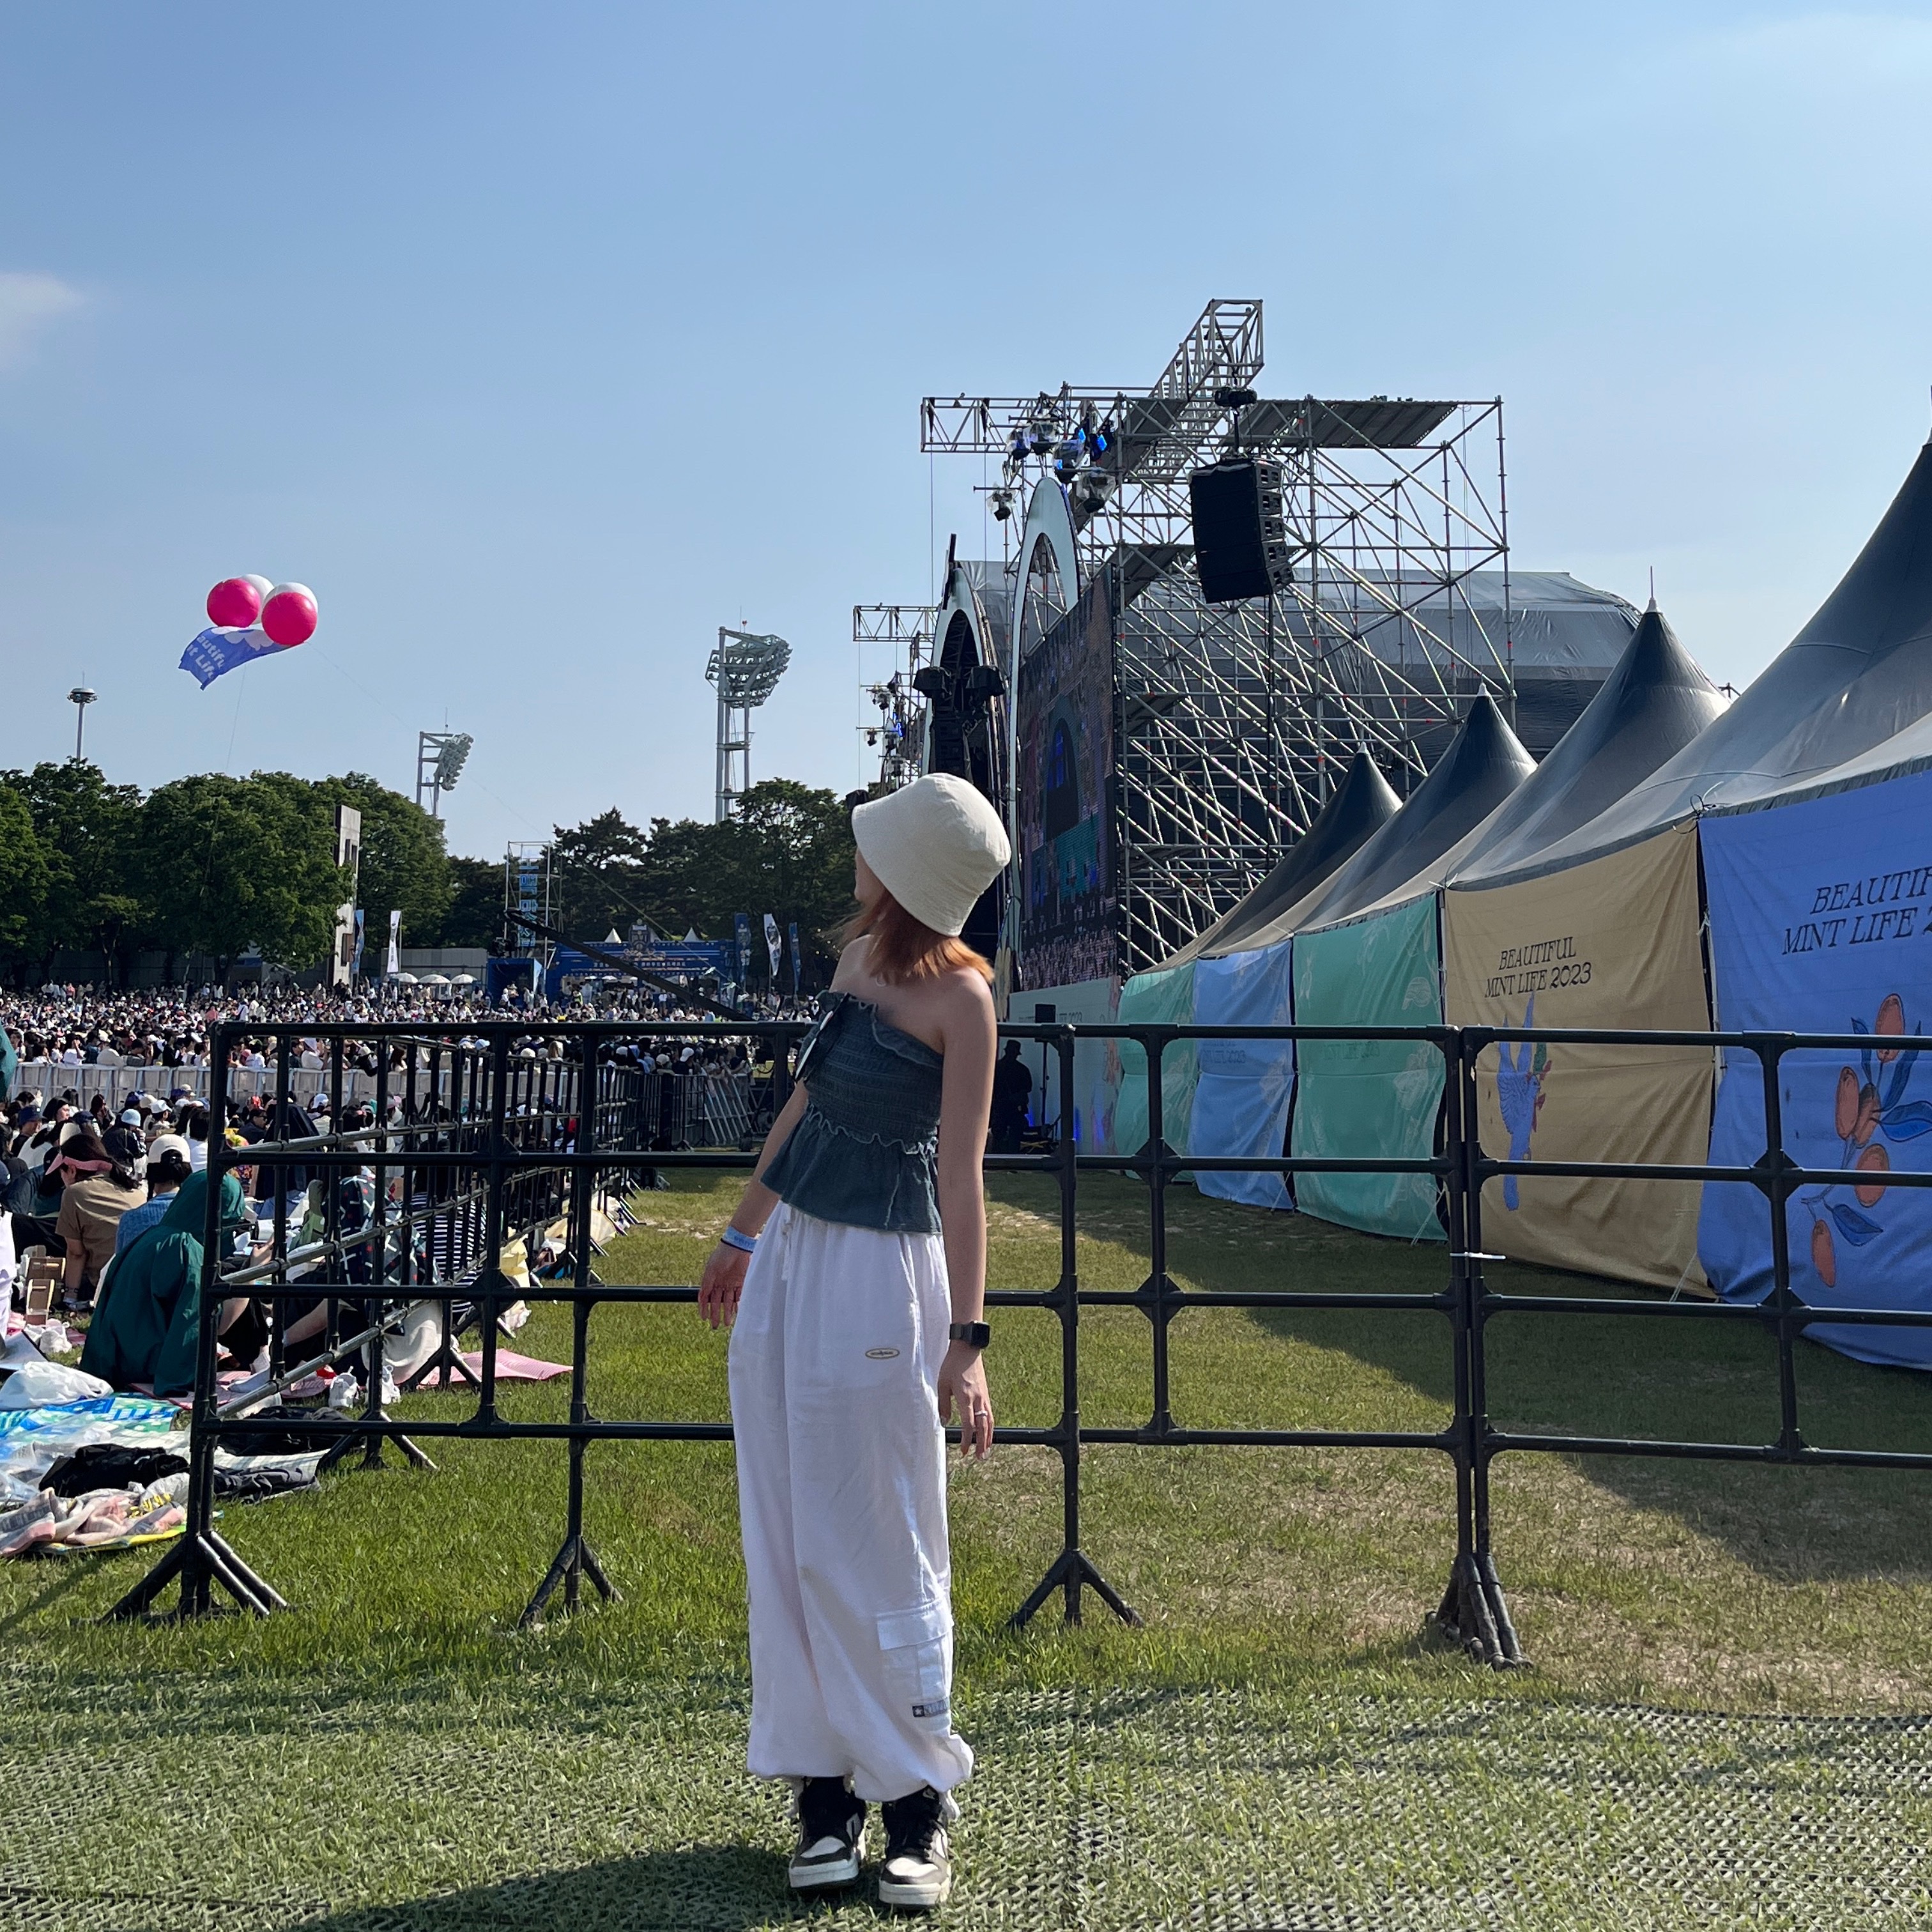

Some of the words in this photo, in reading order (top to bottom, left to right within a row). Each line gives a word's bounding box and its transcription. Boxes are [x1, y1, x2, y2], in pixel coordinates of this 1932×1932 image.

[1782, 918, 1846, 955] MINT
[1849, 907, 1918, 944] LIFE
[1498, 937, 1576, 970] BEAUTIFUL
[1484, 974, 1516, 998] MINT
[1517, 969, 1547, 993] LIFE
[1550, 962, 1591, 988] 2023
